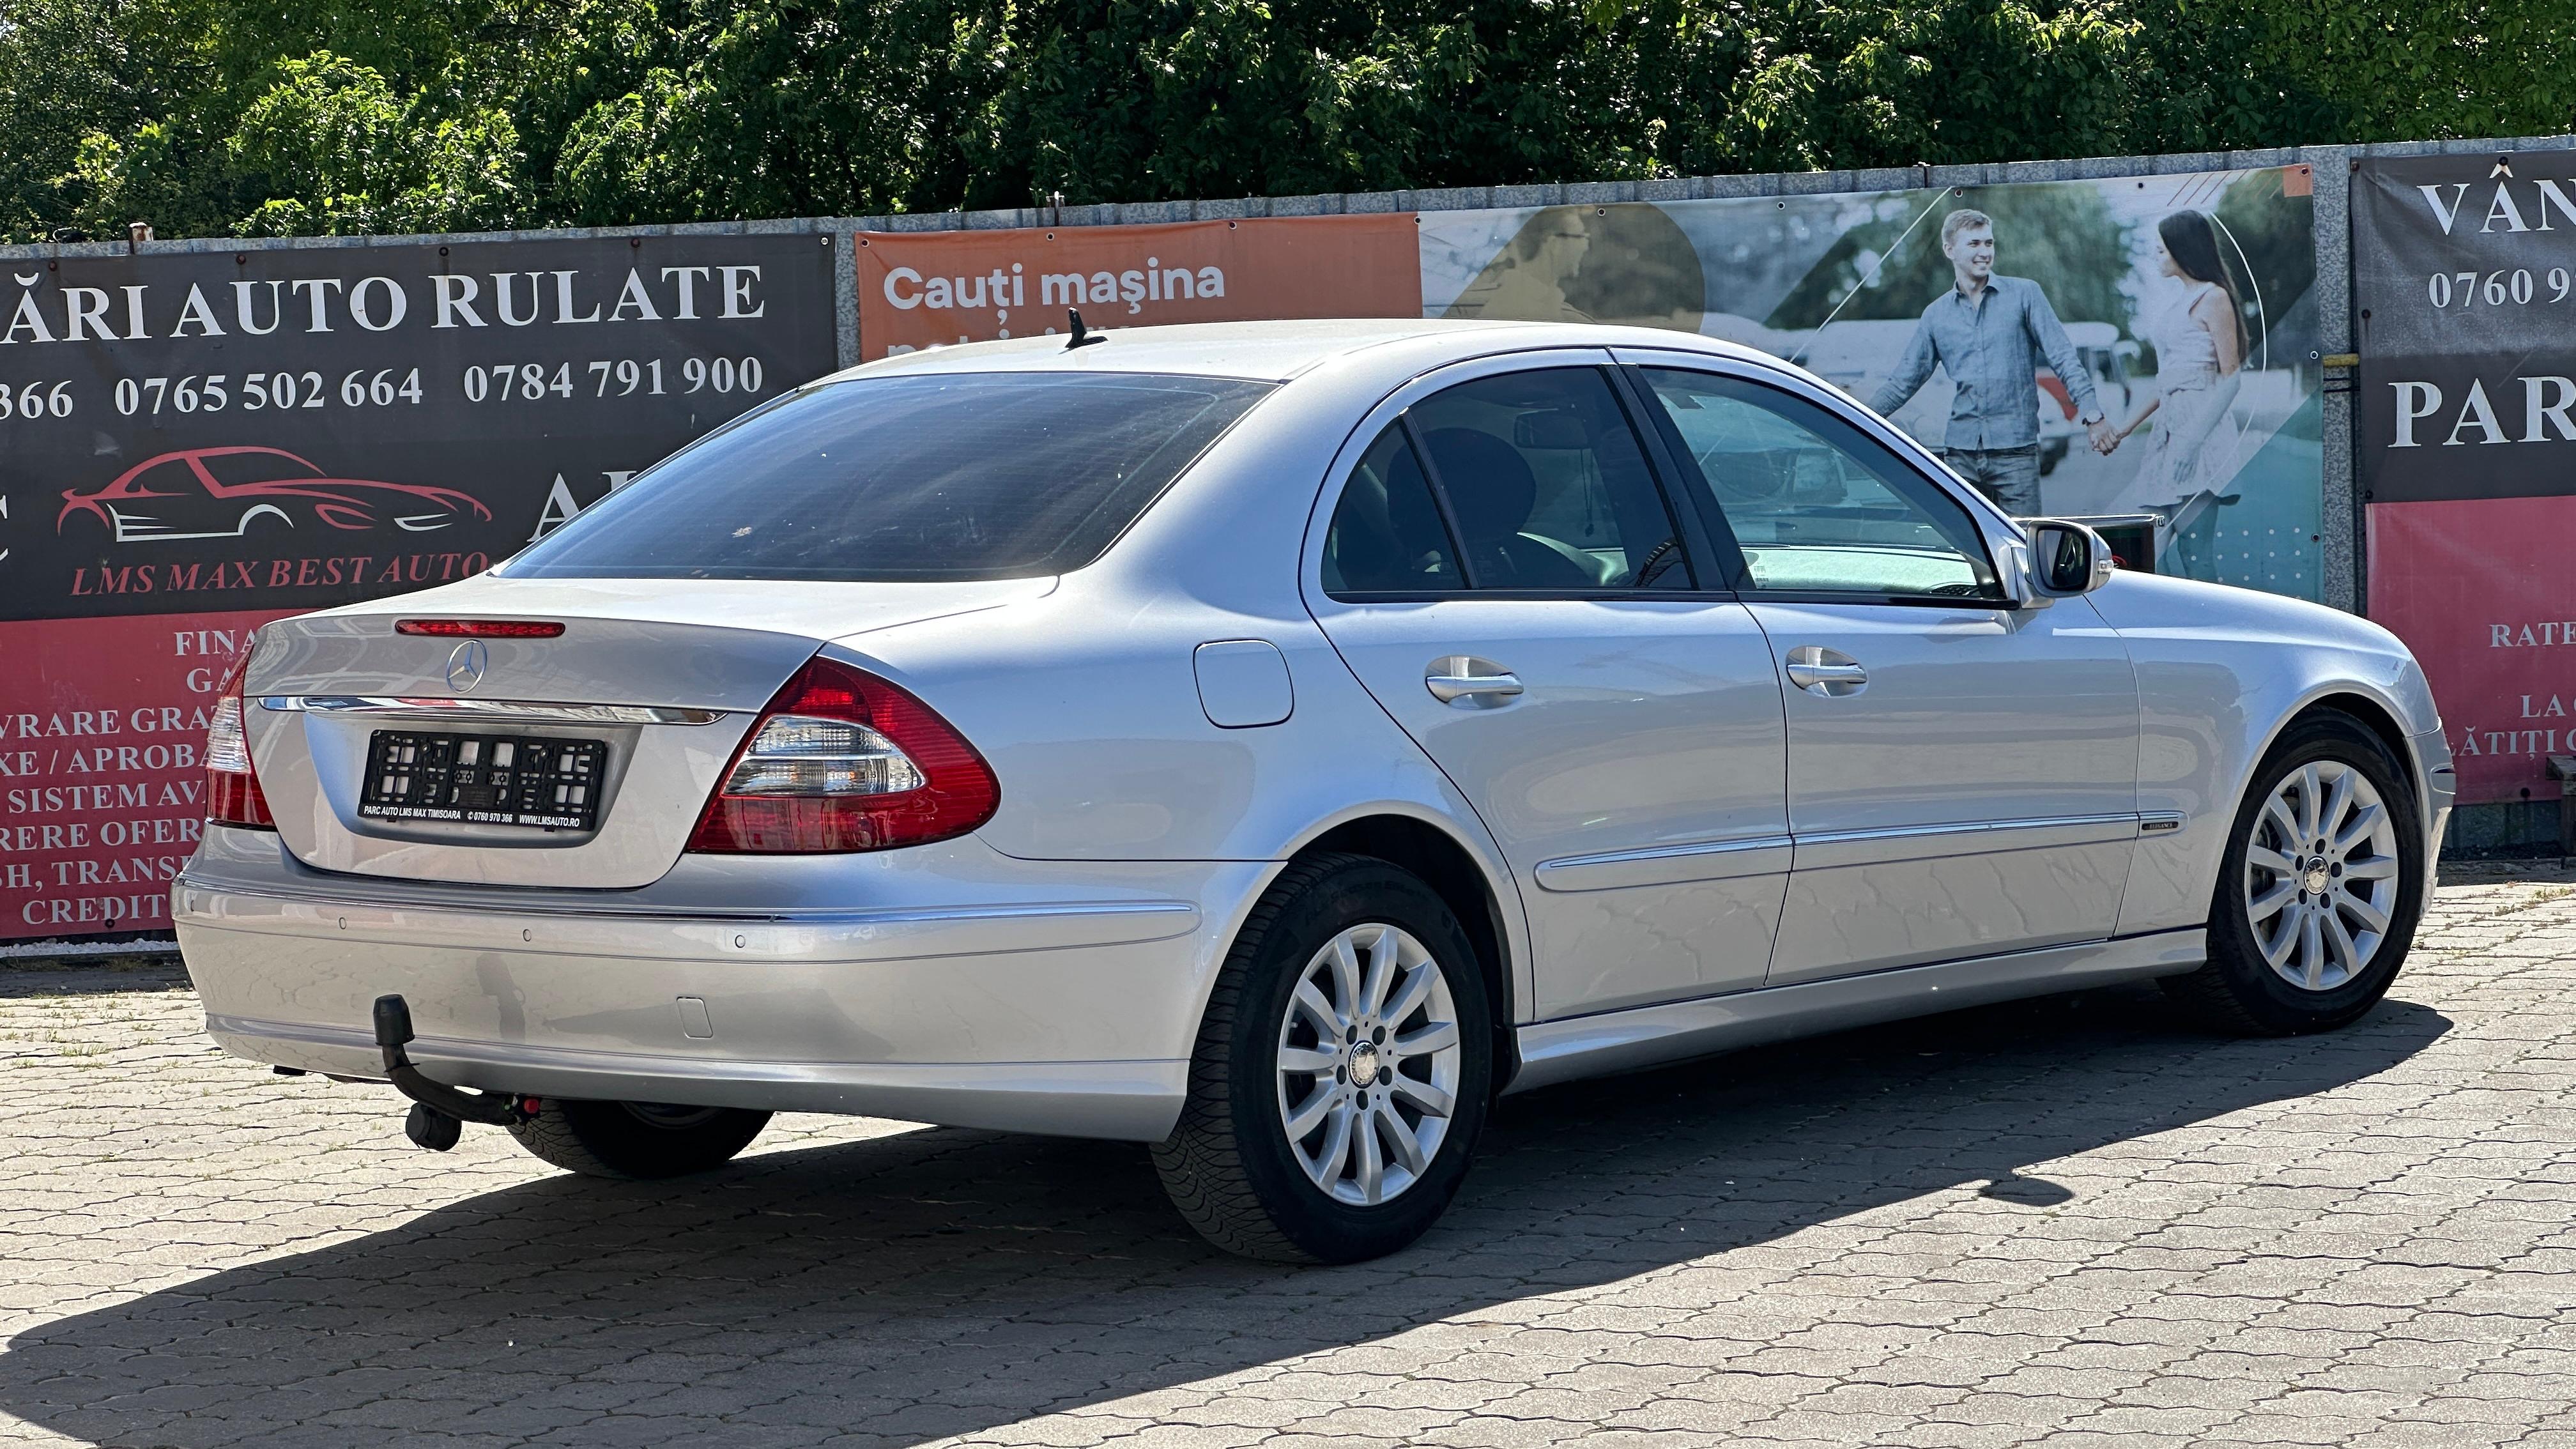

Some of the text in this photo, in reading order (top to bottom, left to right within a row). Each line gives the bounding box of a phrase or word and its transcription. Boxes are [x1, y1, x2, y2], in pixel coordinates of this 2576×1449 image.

[2417, 163, 2576, 236] VÂN
[170, 277, 407, 337] AUTO
[428, 266, 764, 328] RULATE
[884, 263, 1023, 325] Cauți
[2428, 269, 2533, 308] 0760
[115, 376, 227, 415] 0765
[243, 371, 325, 410] 502
[341, 367, 423, 407] 664
[464, 362, 573, 402] 0784
[588, 358, 666, 397] 791
[683, 356, 762, 394] 900
[2388, 376, 2576, 447] PAR
[70, 551, 488, 596] LMS MAX BEST AUTO
[131, 706, 217, 733] GRA
[2520, 694, 2566, 718] LA
[2450, 725, 2557, 760] ĂTIȚI
[8, 780, 205, 813] SISTEM AV
[364, 805, 381, 815] PARC
[381, 806, 399, 816] AUTO
[399, 807, 412, 817] LMS
[413, 808, 427, 818] MAX
[428, 809, 461, 819] TIMISOARA
[473, 811, 489, 822] 0760
[489, 812, 501, 822] 970
[519, 814, 580, 827] WWW.LMSAUTO.RO
[22, 894, 166, 925] CREDIT
